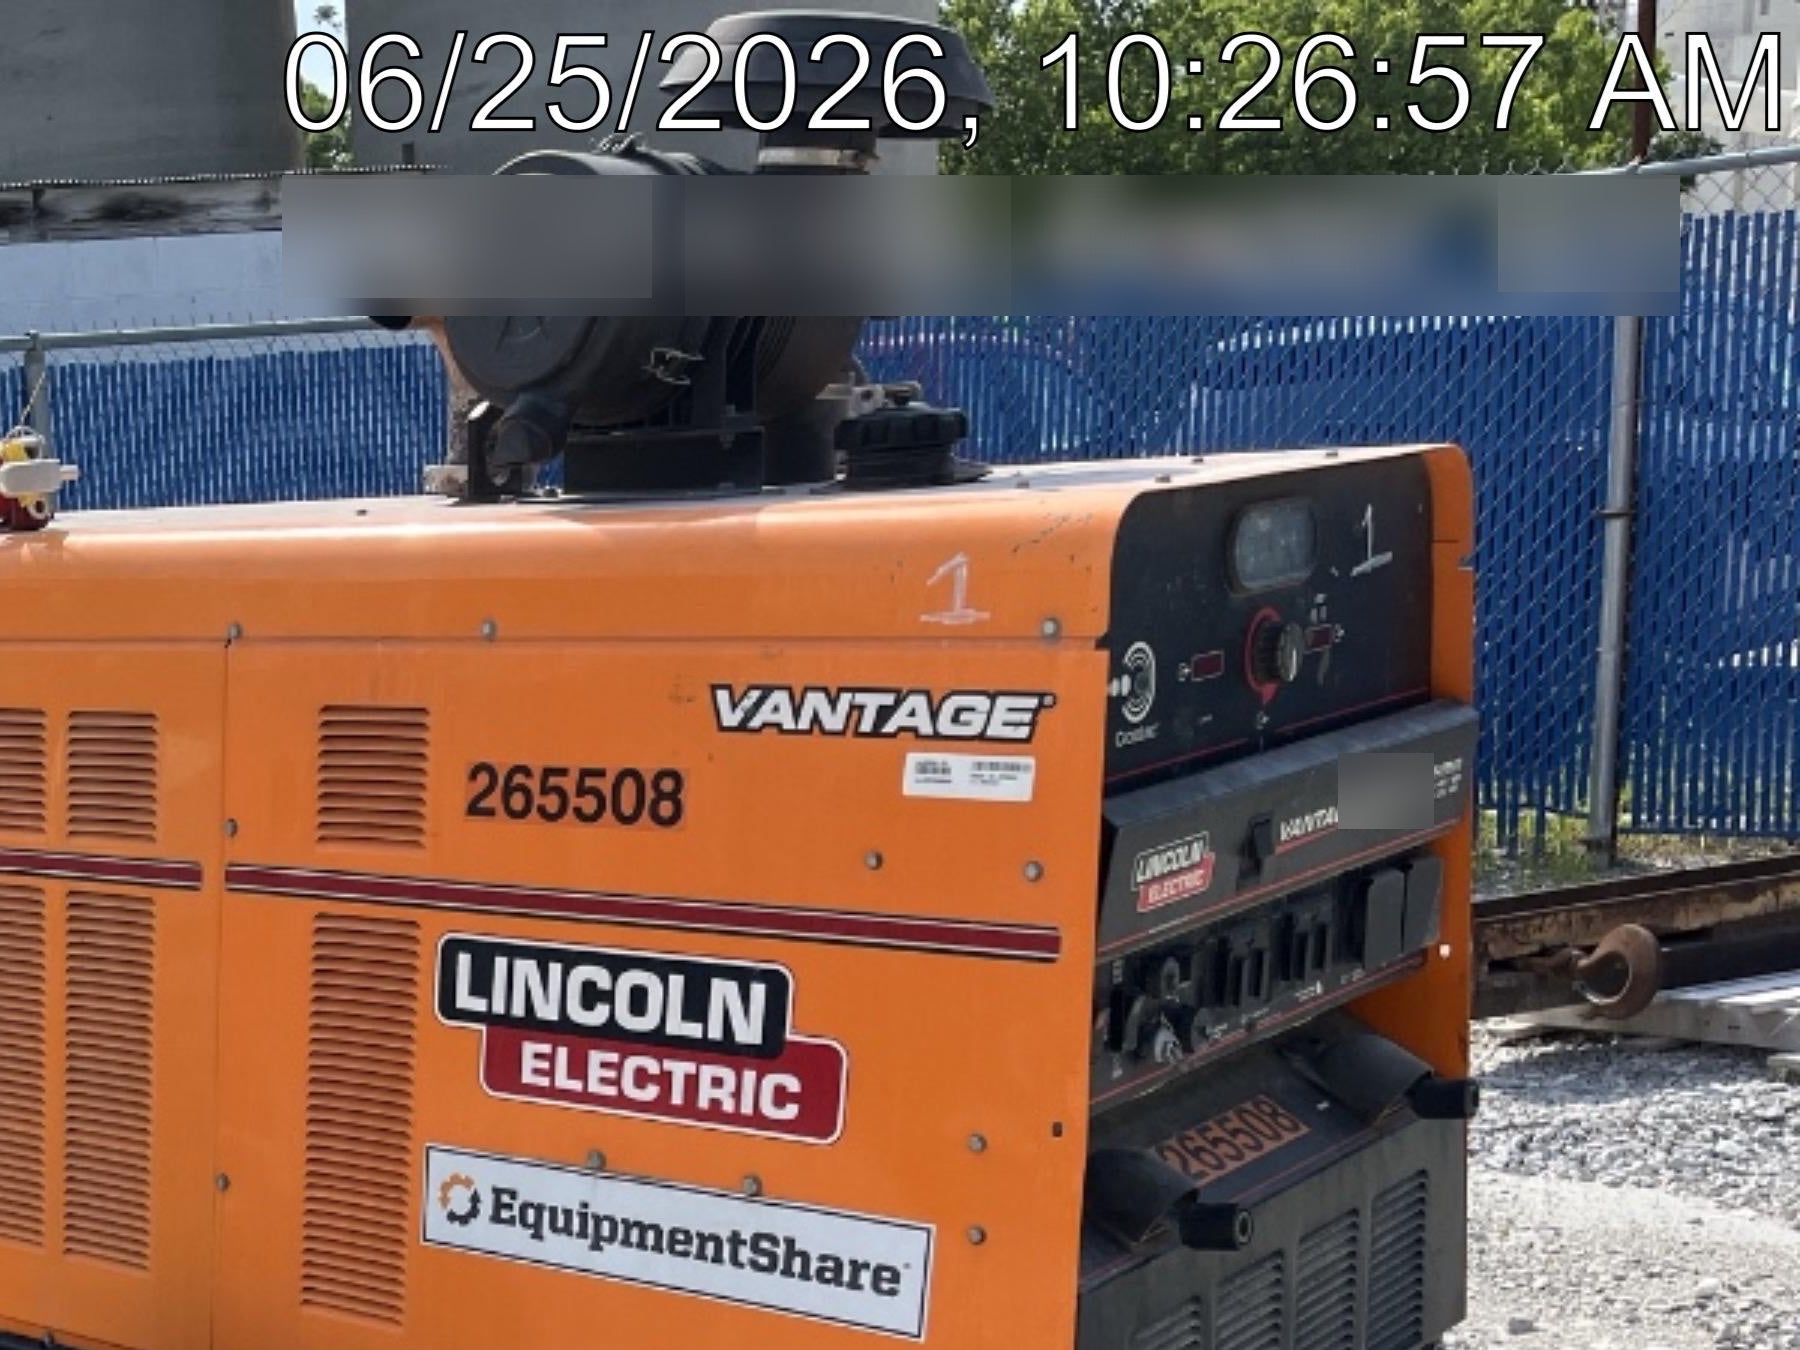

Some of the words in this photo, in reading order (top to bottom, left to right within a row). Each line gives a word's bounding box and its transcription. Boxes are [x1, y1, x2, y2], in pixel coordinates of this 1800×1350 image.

[1351, 503, 1394, 577] 1
[919, 551, 991, 625] 1
[465, 761, 686, 828] 265508
[454, 951, 767, 1045] LINCOLN
[519, 1041, 802, 1121] ELECTRIC
[1157, 1098, 1302, 1180] 265508
[488, 1184, 902, 1297] EquipmentShare
